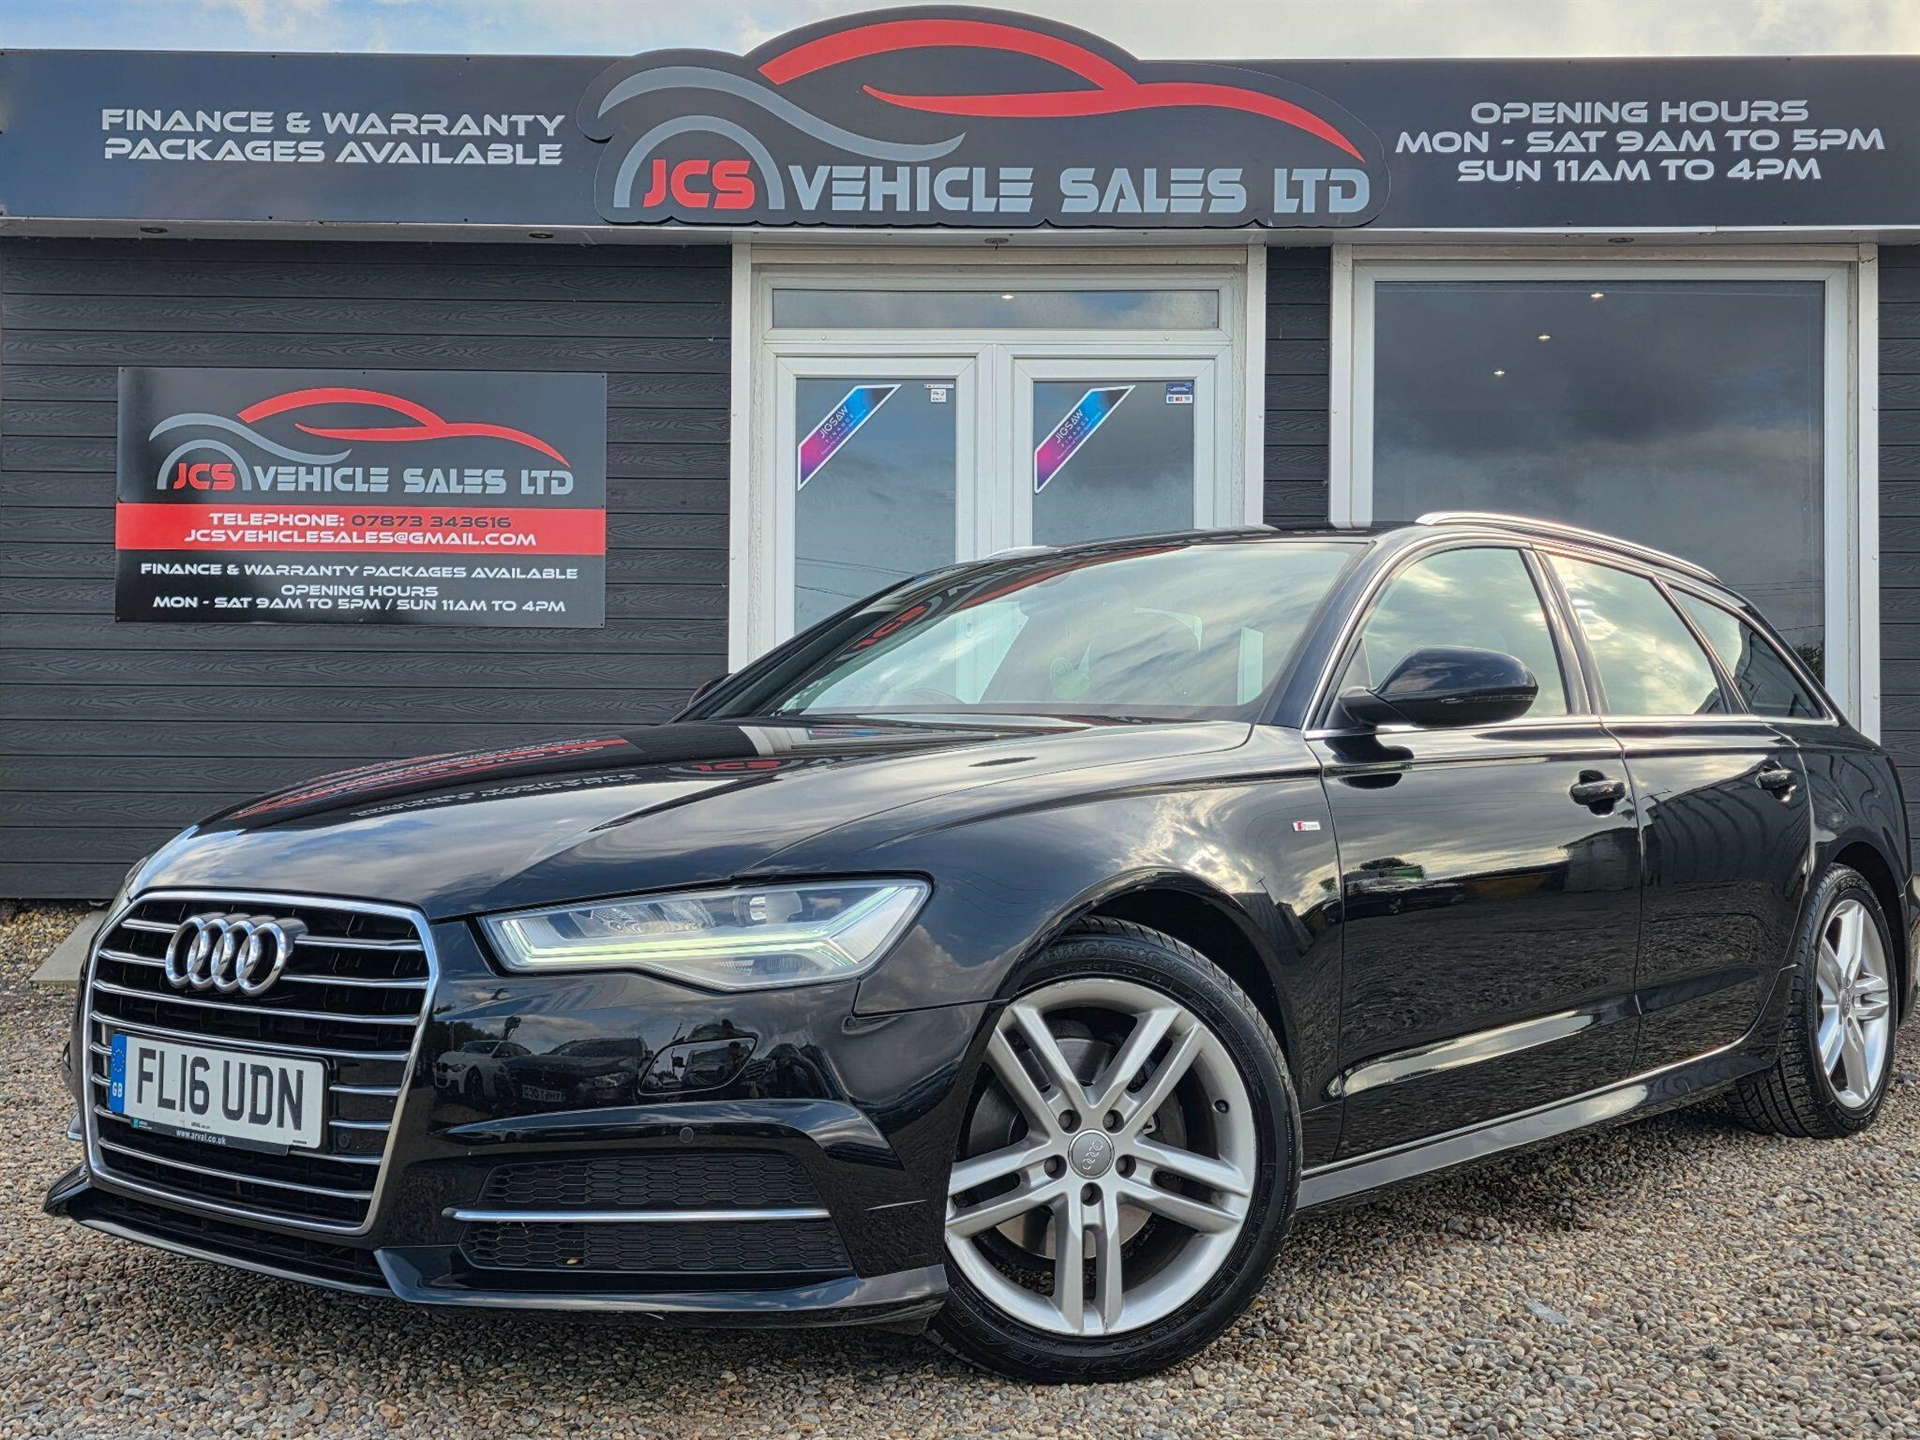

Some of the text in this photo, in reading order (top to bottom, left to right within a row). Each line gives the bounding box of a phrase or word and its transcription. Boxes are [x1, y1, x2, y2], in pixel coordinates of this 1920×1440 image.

[101, 108, 566, 137] FINANCE & WARRANTY
[1470, 99, 1809, 124] OPENING HOURS
[104, 137, 563, 165] PACKAGES AVAILABLE
[1395, 131, 1489, 154] MON
[1526, 130, 1608, 153] SAT
[1615, 129, 1716, 153] 9AM
[1724, 129, 1780, 152] TO
[1792, 127, 1886, 151] 5PM
[1457, 157, 1822, 182] SUN 11AM TO 4PM
[643, 159, 1370, 214] JCS VEHICLE SALES LTD
[819, 405, 849, 439] JIGSAW
[1055, 409, 1084, 443] JIGSAW
[173, 462, 574, 495] JCS VEHICLE SALES LTD
[209, 512, 512, 529] TELEPHONE: 07873 343616
[184, 529, 537, 546] JCSVEHICLESALES@GMAIL.COM
[140, 563, 578, 580] FINANCE & WARRANTY PACKAGES AVAILABLE
[280, 584, 439, 597] OPENING HOURS
[152, 596, 198, 608] MON
[214, 597, 253, 609] SAT
[255, 597, 303, 609] 9AM
[306, 598, 333, 610] TO
[337, 598, 381, 610] 5PM
[385, 598, 393, 611] /
[396, 599, 437, 611] SUN
[441, 599, 488, 611] 11AM
[490, 600, 517, 612] TO
[521, 600, 566, 612] 4PM
[112, 1081, 123, 1098] GB
[137, 1047, 304, 1131] FL16 UDN
[176, 1129, 226, 1146] www.arval.co.uk
